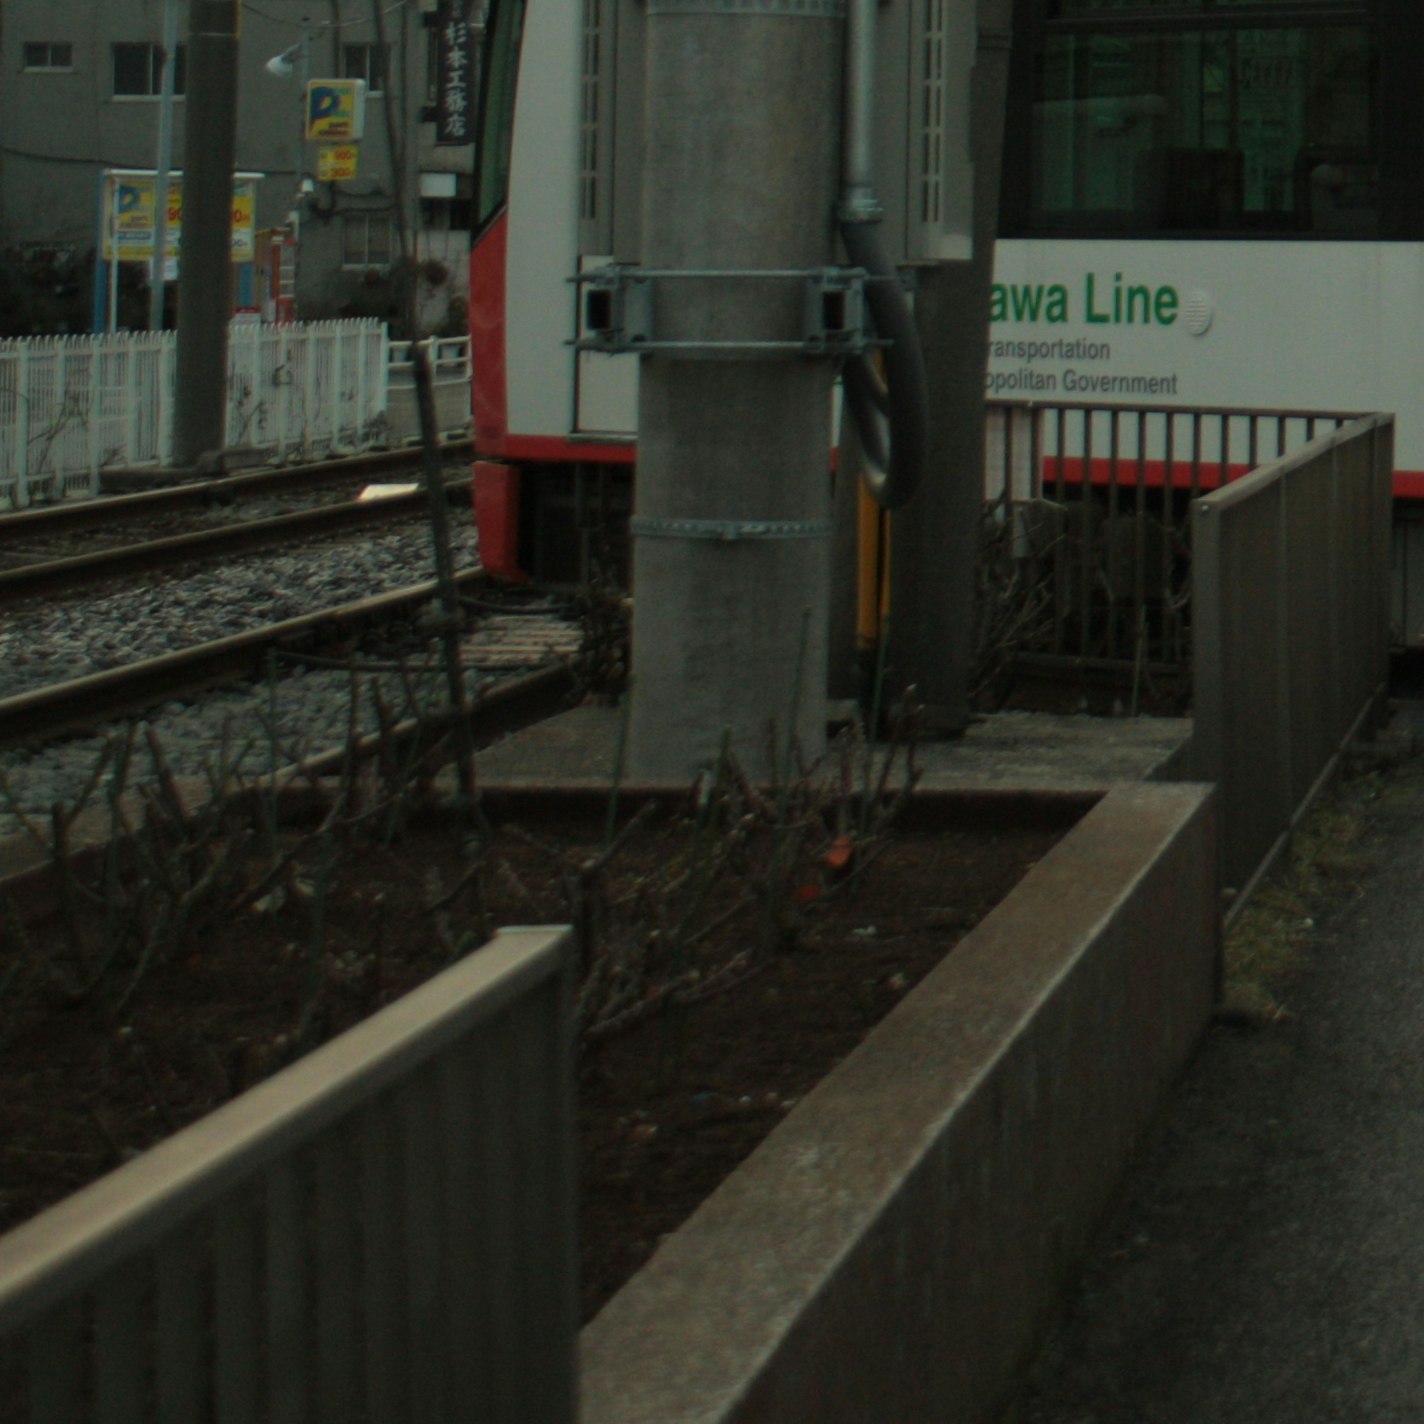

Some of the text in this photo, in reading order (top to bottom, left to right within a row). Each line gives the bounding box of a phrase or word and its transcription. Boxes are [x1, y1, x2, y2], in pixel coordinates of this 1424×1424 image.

[445, 21, 468, 137] 杉本工務店
[1085, 272, 1179, 326] Line
[1062, 369, 1178, 394] Government
